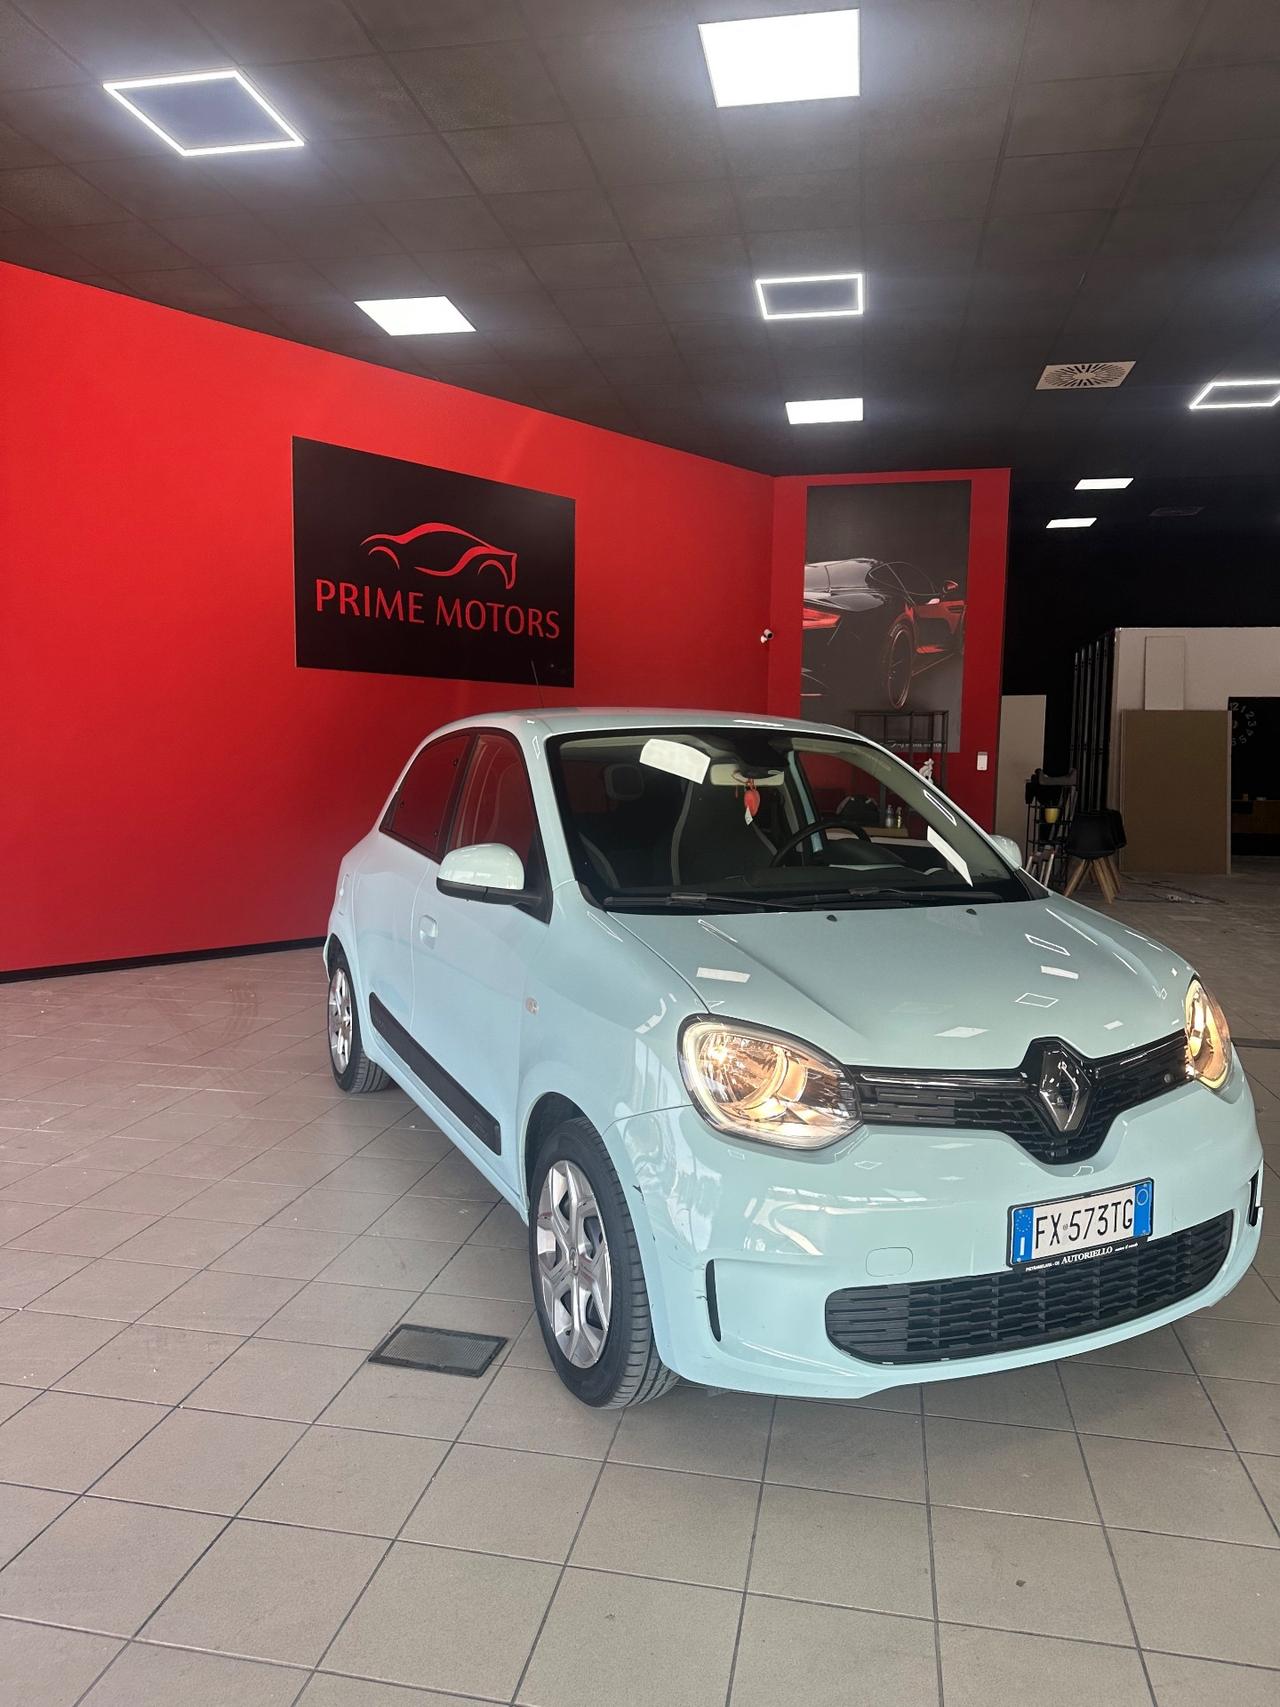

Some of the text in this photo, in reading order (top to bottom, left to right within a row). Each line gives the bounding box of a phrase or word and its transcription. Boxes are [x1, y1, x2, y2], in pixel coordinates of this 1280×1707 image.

[315, 578, 560, 639] PRIME MOTORS
[1245, 711, 1255, 720] 2
[1035, 1199, 1133, 1249] FX 573TG
[1019, 1236, 1026, 1256] I
[1061, 1246, 1113, 1265] AUTORIELLO
